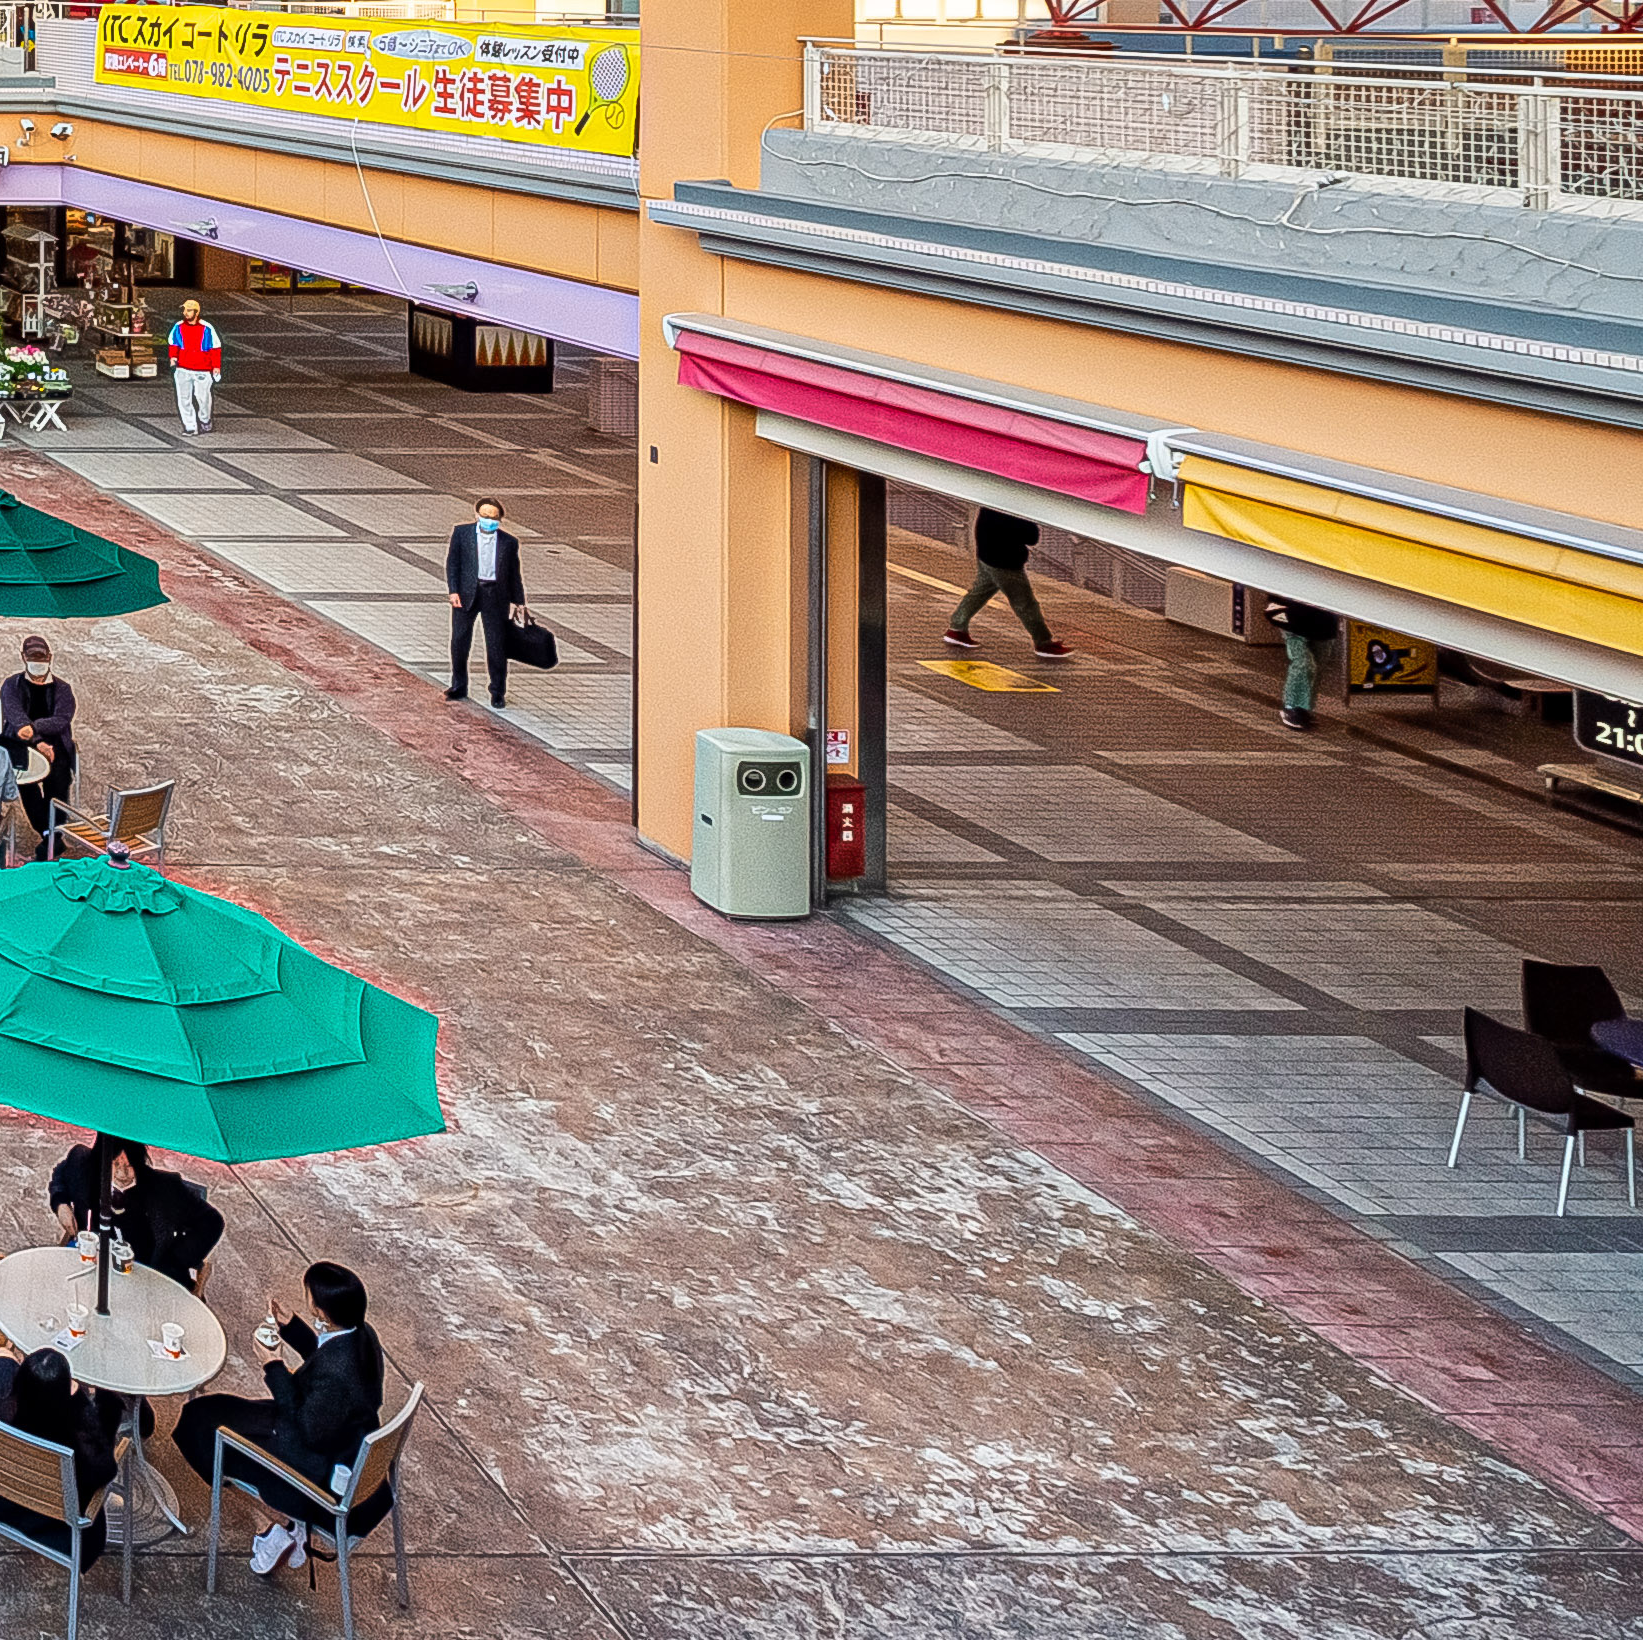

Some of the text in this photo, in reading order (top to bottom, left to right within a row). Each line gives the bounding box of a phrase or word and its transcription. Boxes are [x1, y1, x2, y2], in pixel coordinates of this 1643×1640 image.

[480, 40, 580, 65] 体験レッスン受付中
[274, 57, 574, 129] テニススクール 生徒募集中
